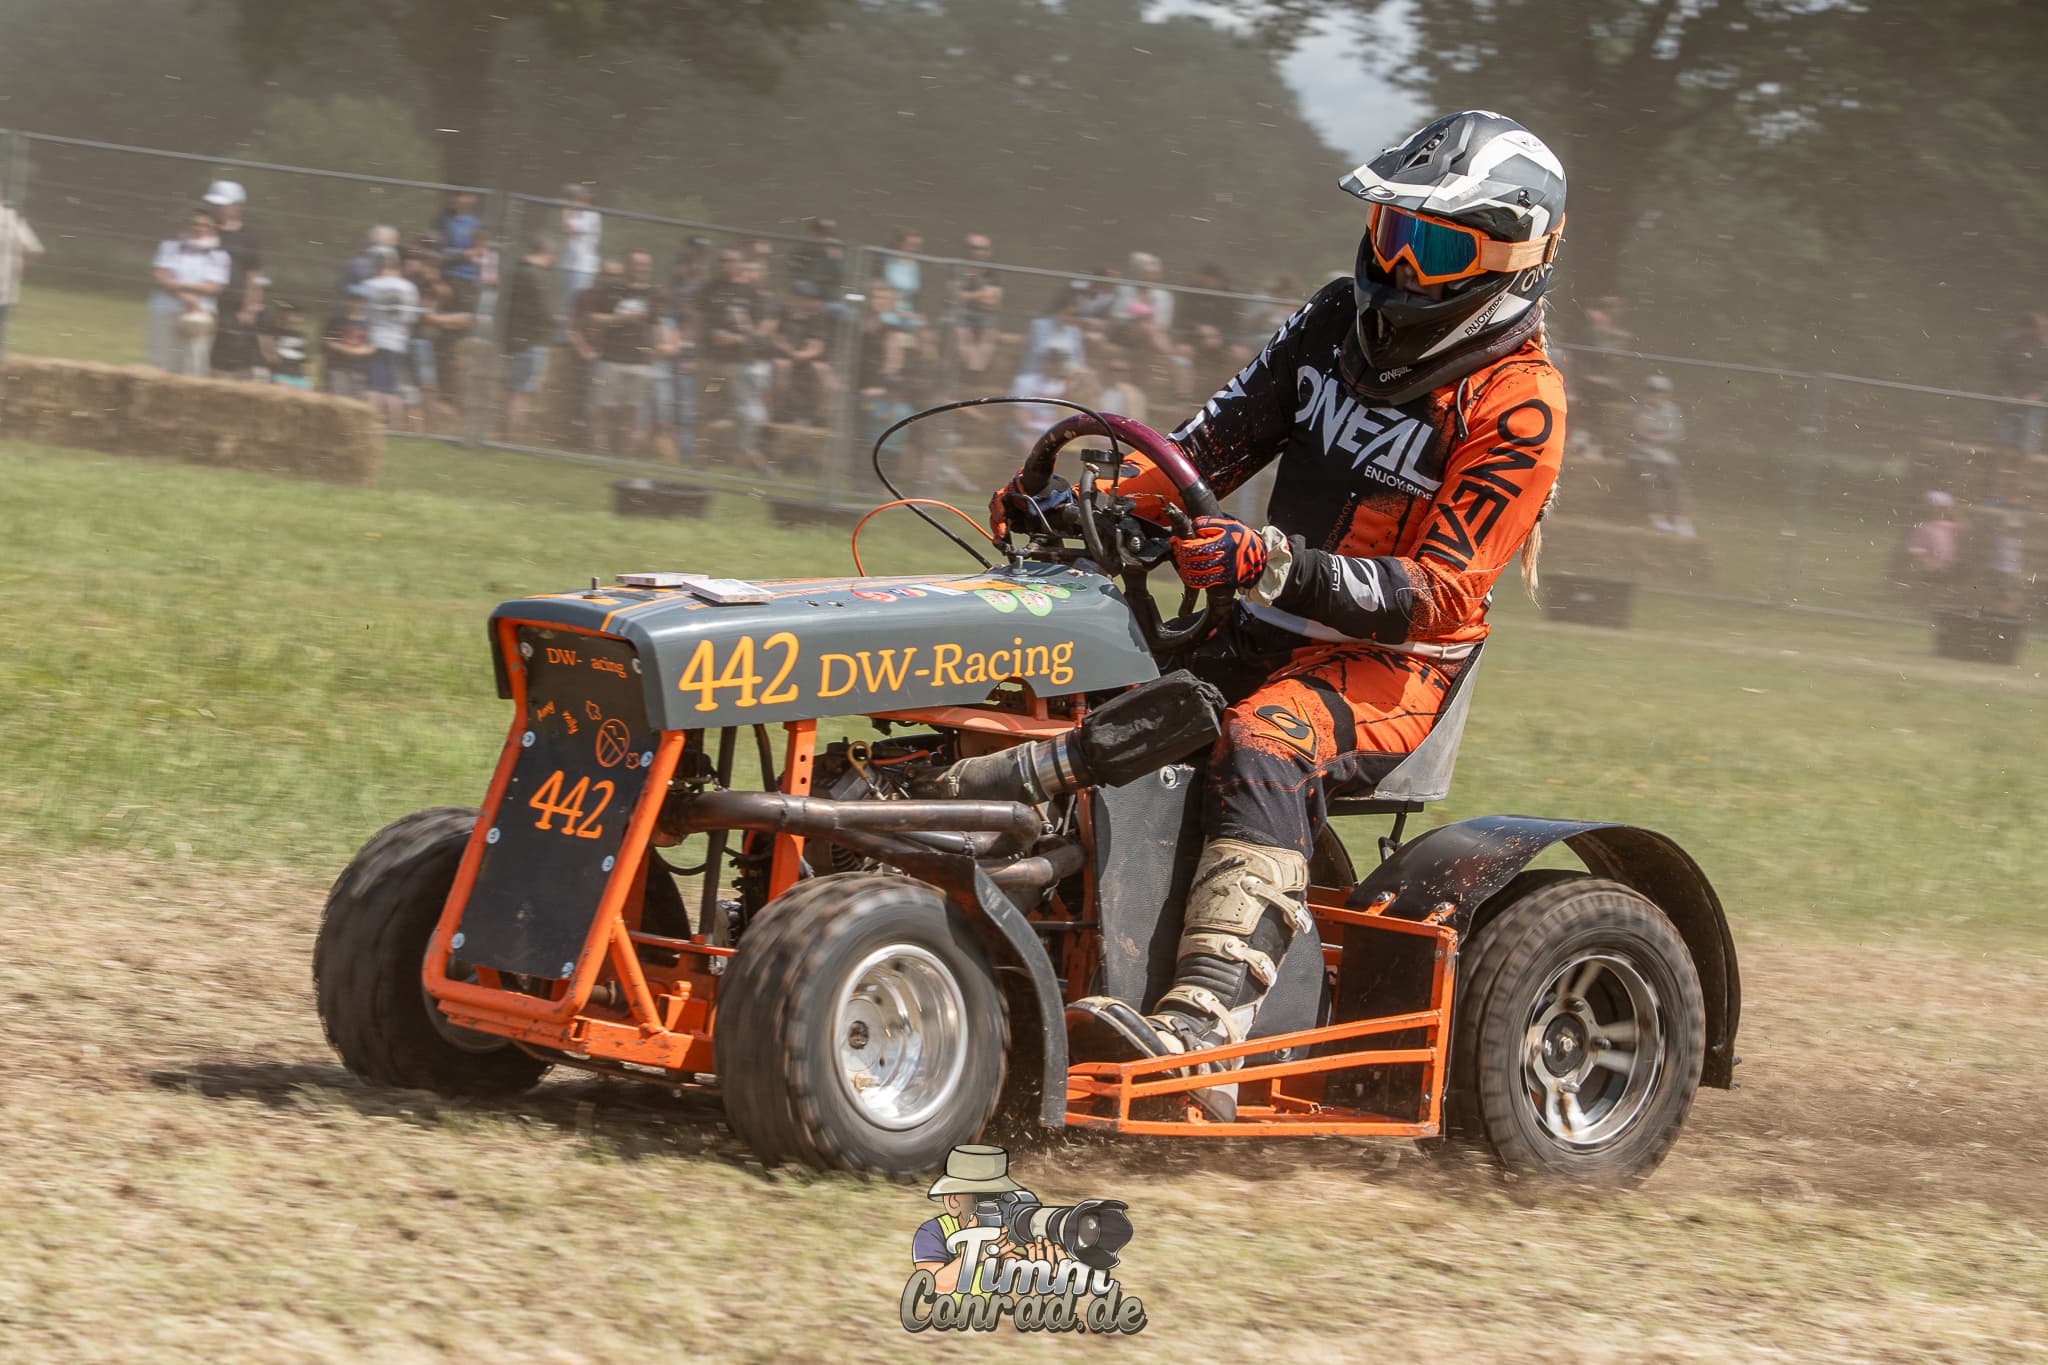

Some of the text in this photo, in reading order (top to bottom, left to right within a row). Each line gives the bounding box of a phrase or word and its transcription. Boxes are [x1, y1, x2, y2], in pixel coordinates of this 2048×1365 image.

[679, 631, 1075, 712] 442 DW-Racing
[529, 770, 616, 839] 442
